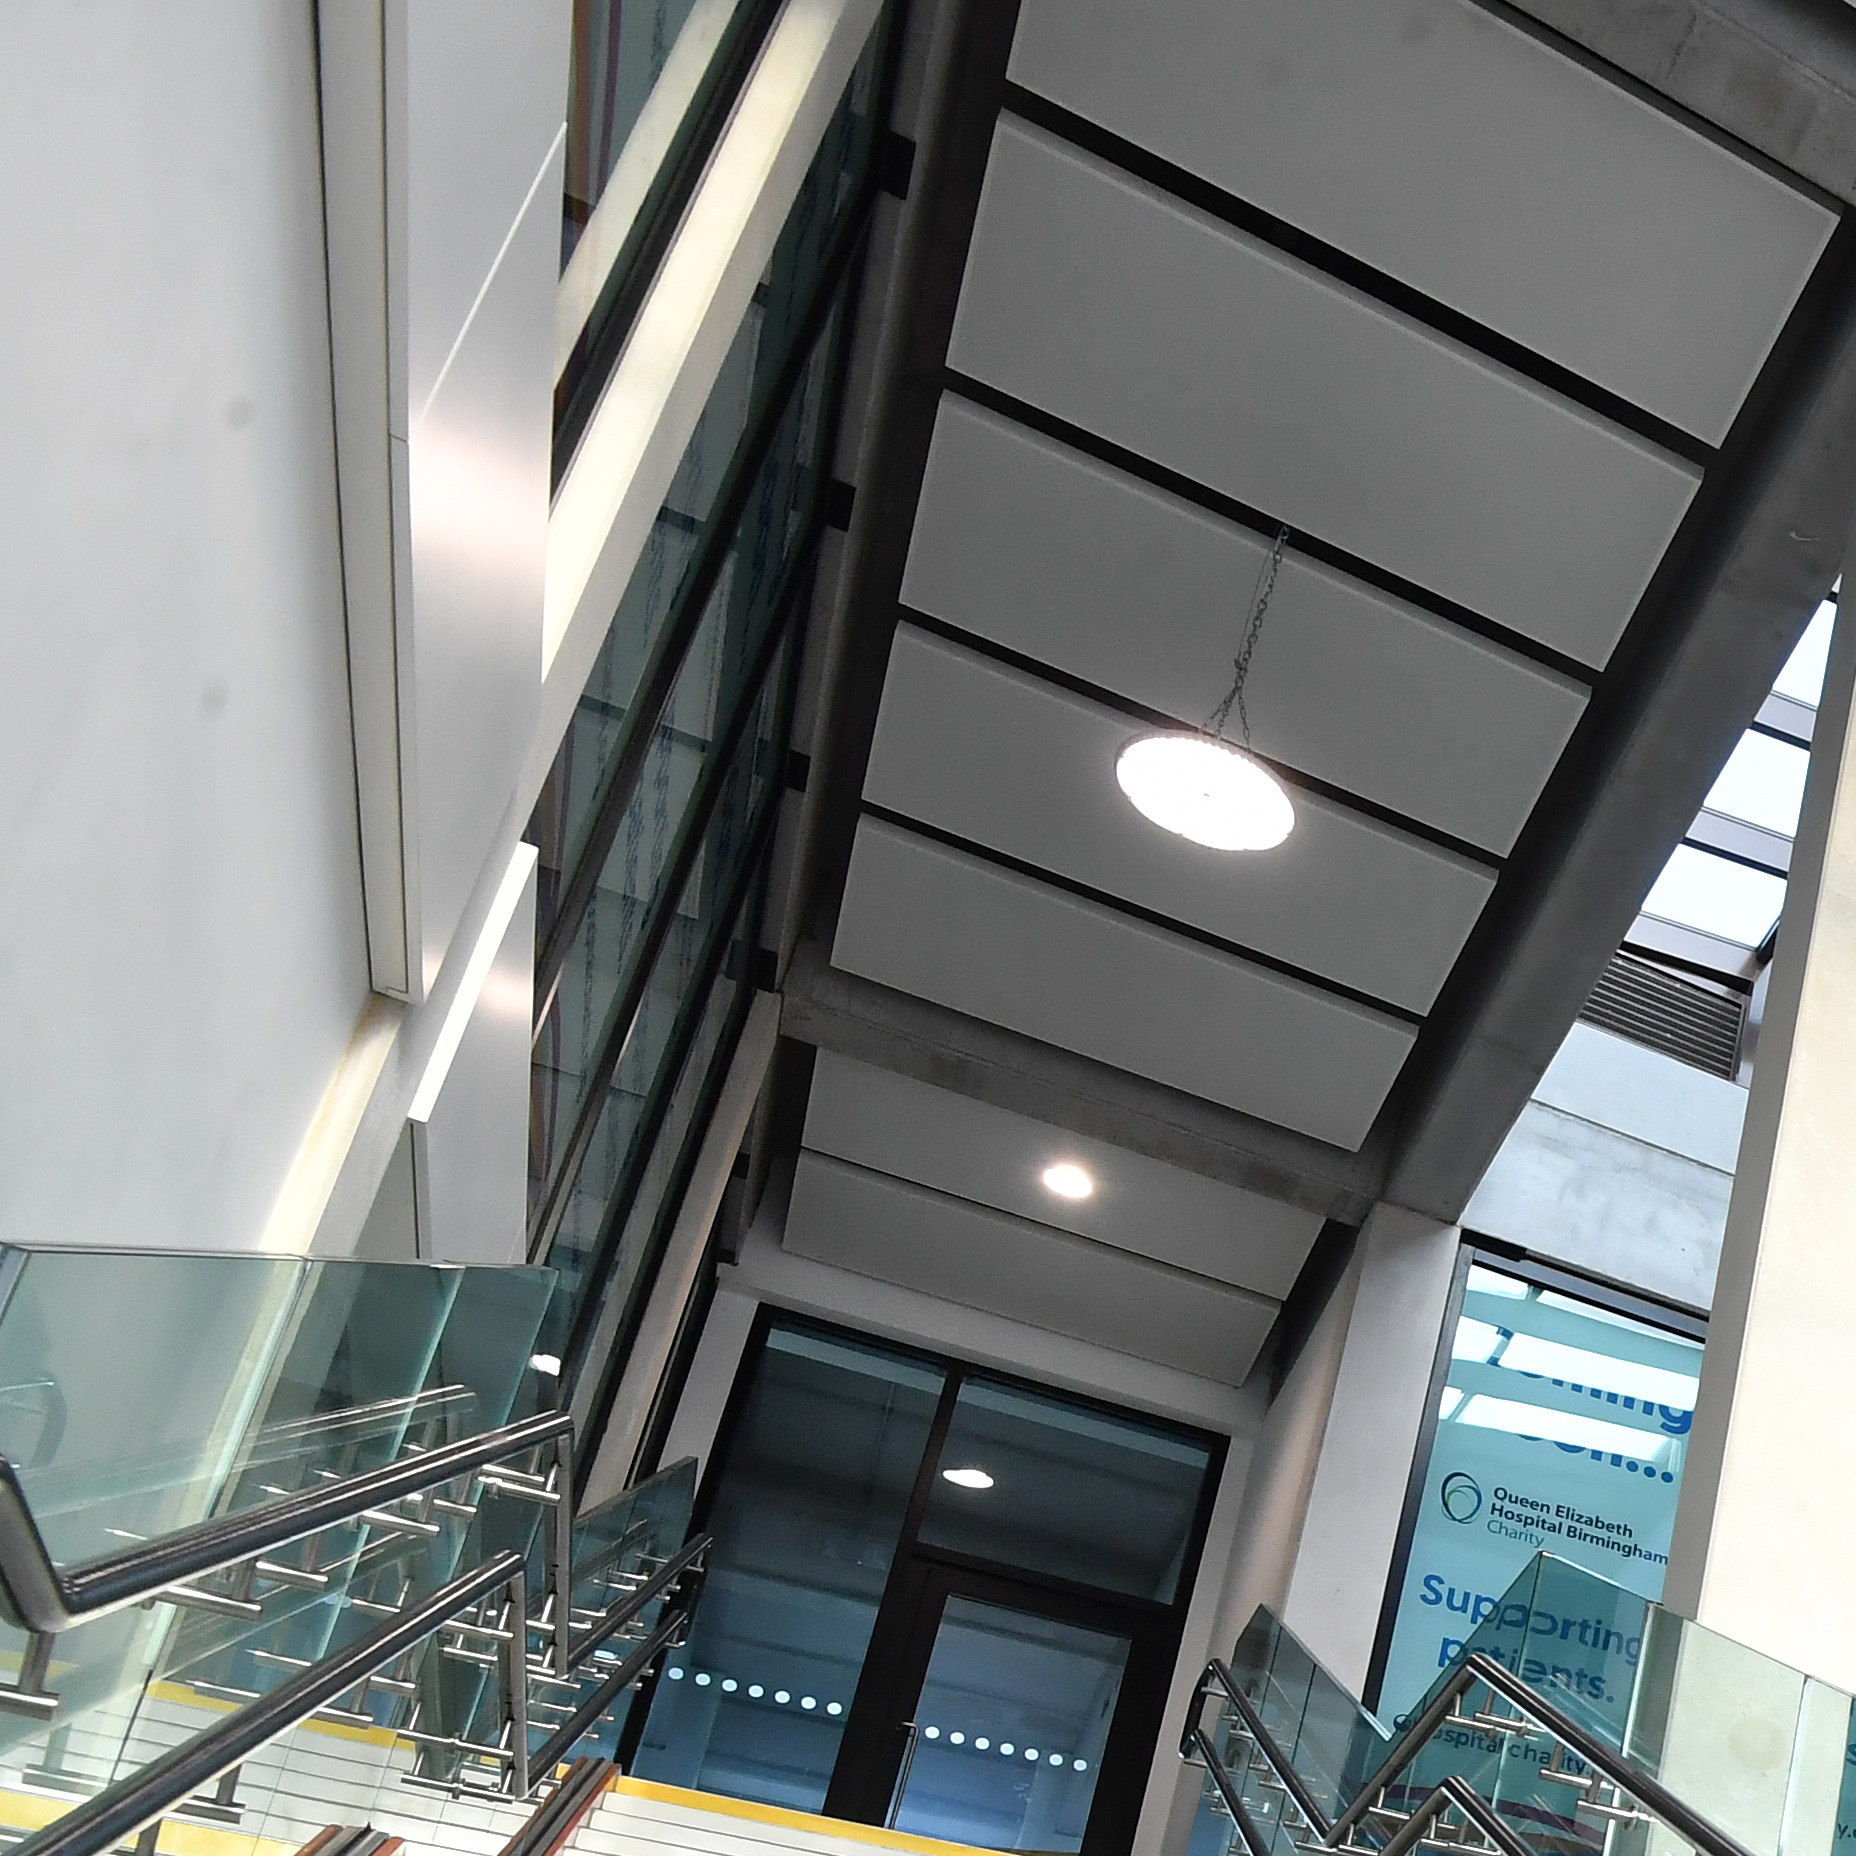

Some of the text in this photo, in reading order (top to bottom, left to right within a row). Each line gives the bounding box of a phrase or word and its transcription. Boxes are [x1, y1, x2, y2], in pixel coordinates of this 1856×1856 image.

[1487, 1519, 1545, 1548] Charity
[1490, 1502, 1668, 1566] Hospital Birmingham
[1493, 1487, 1633, 1538] Queen Elizabeth
[1419, 1574, 1641, 1666] Supporting
